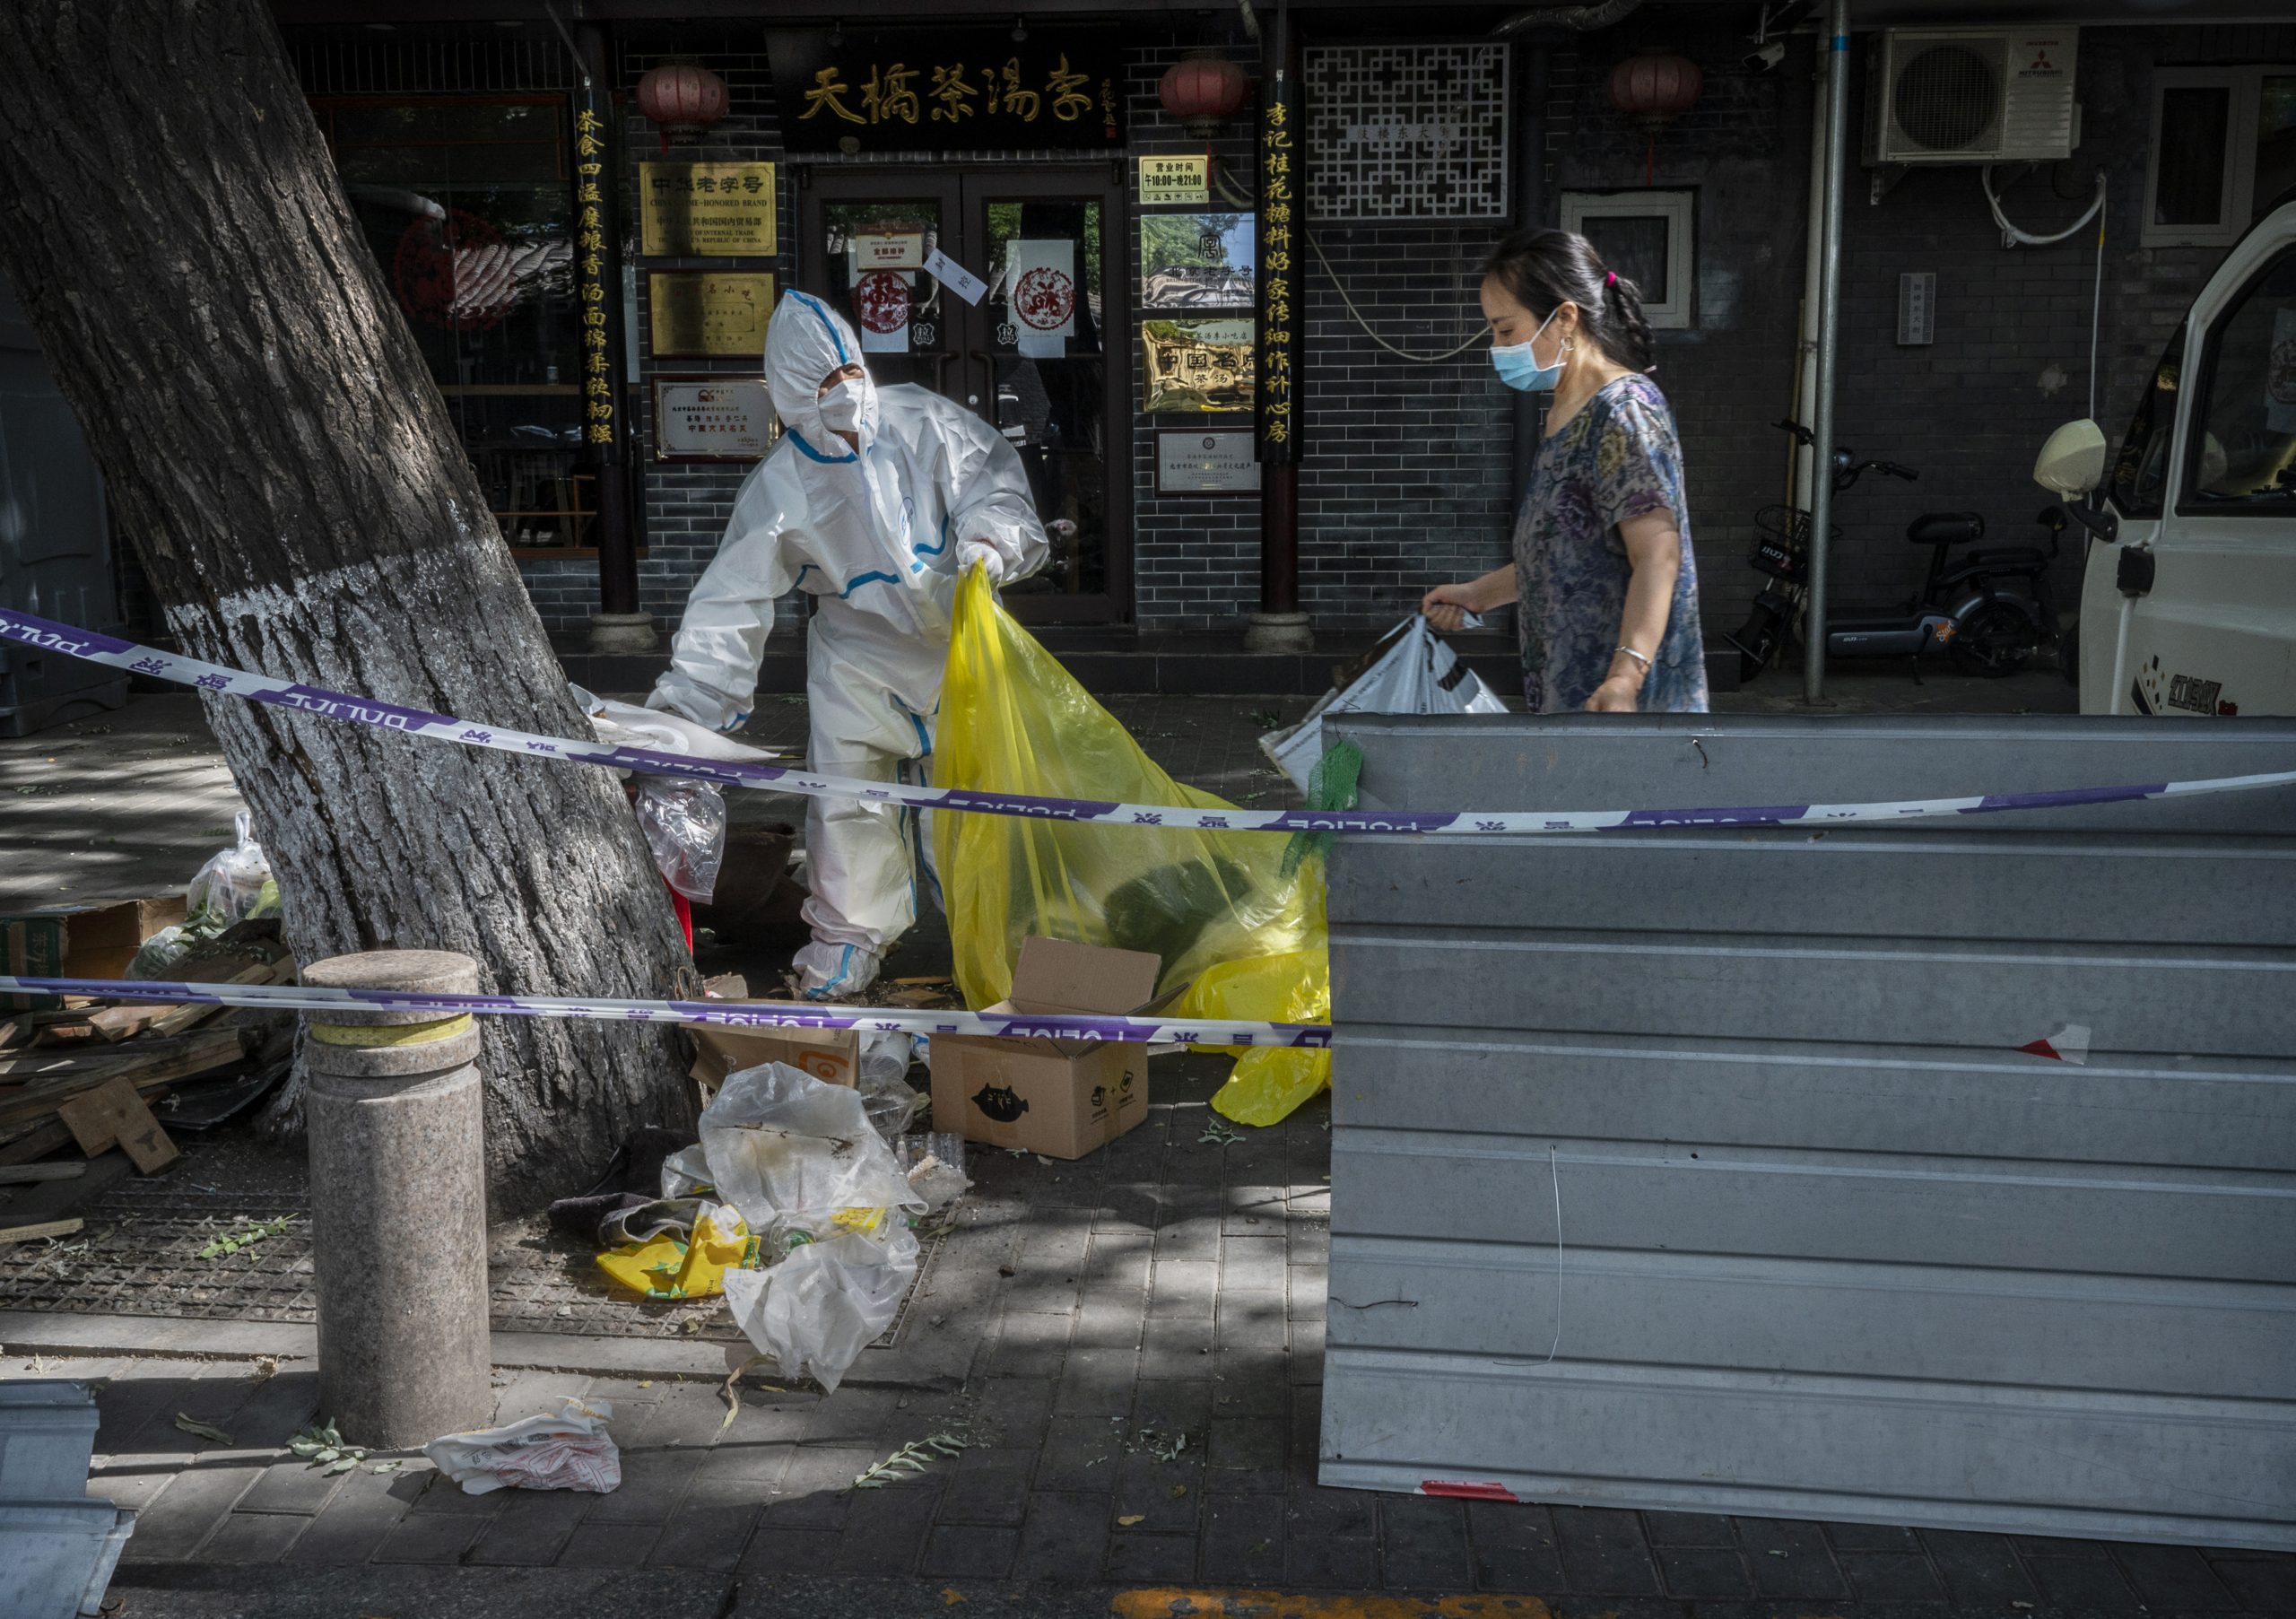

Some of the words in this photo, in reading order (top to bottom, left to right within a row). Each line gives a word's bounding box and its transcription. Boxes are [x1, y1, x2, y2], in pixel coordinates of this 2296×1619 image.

[1156, 162, 1194, 172] 营业时间
[743, 199, 767, 207] BRAND
[0, 617, 91, 656] POLI
